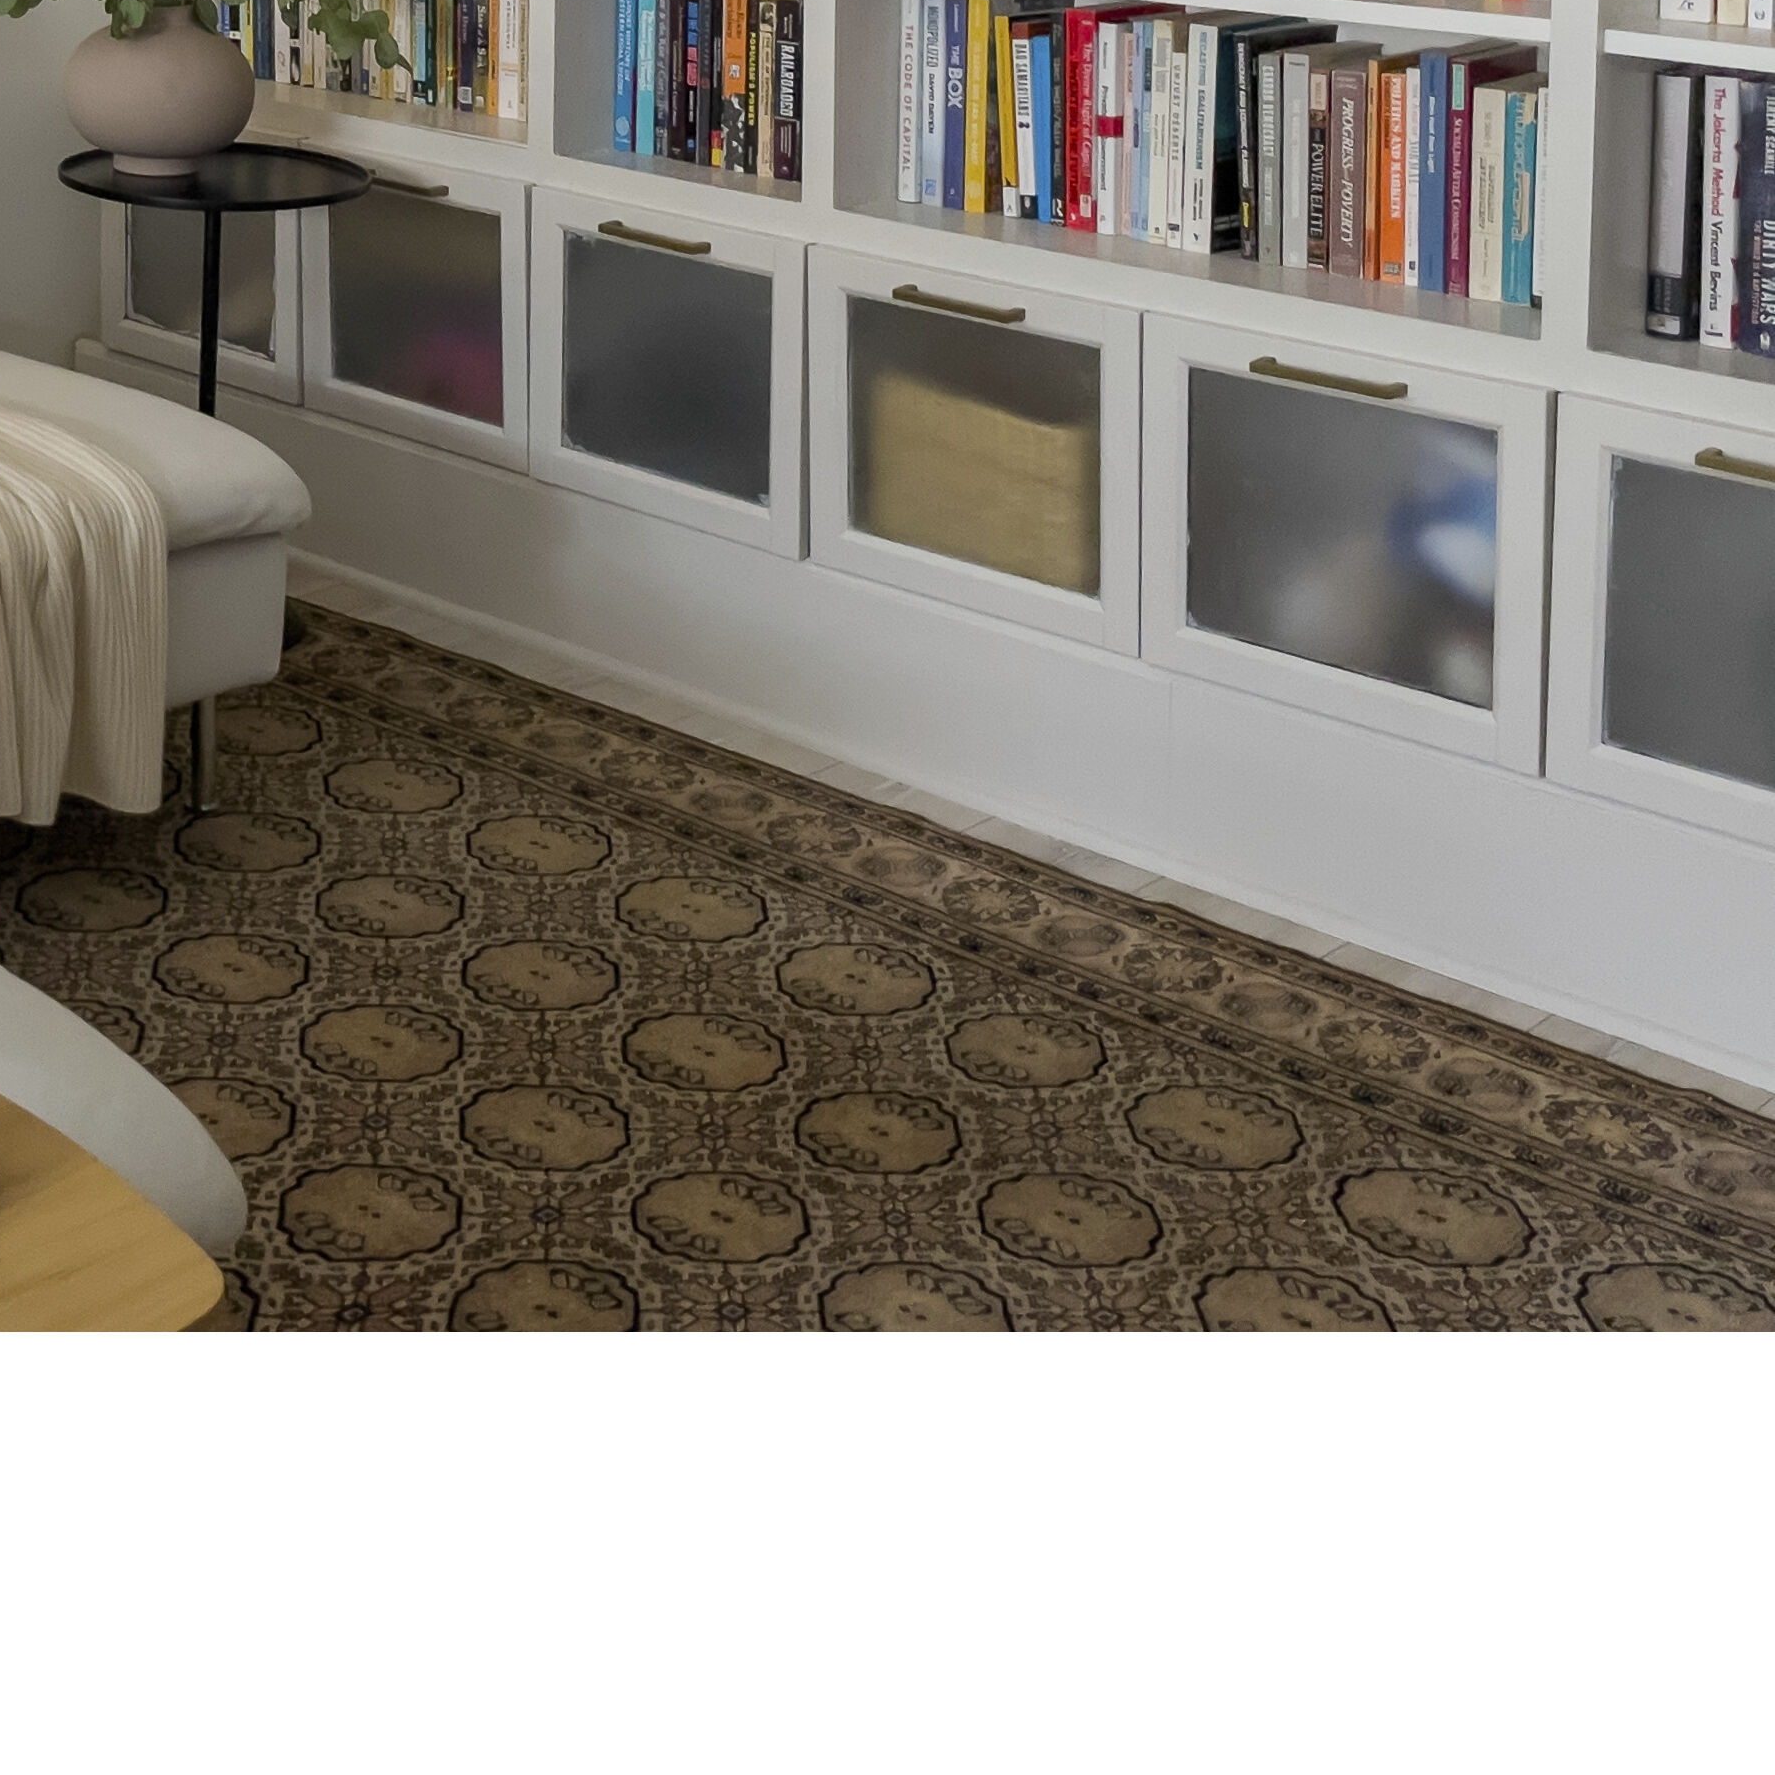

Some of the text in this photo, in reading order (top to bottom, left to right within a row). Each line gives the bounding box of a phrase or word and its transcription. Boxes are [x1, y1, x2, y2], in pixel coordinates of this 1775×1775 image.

[926, 5, 939, 68] MONOPOLIZED
[779, 45, 795, 117] RAILROADED
[902, 25, 913, 174] THE CODE OF CAPITAL
[946, 45, 964, 108] THE BOX
[1173, 65, 1181, 107] UNJUST
[1068, 132, 1078, 155] THE
[1262, 104, 1274, 157] DEMOCRACY
[1390, 76, 1402, 219] POLITICS AND MARKETS
[1068, 157, 1078, 203] FUTURE
[1309, 143, 1324, 238] POWER ELITE
[1340, 97, 1354, 248] PROGRESS POVERTY
[1709, 88, 1726, 311] The Jakarta Method Vincent Bevins
[1760, 220, 1775, 324] DIRTY WARS
